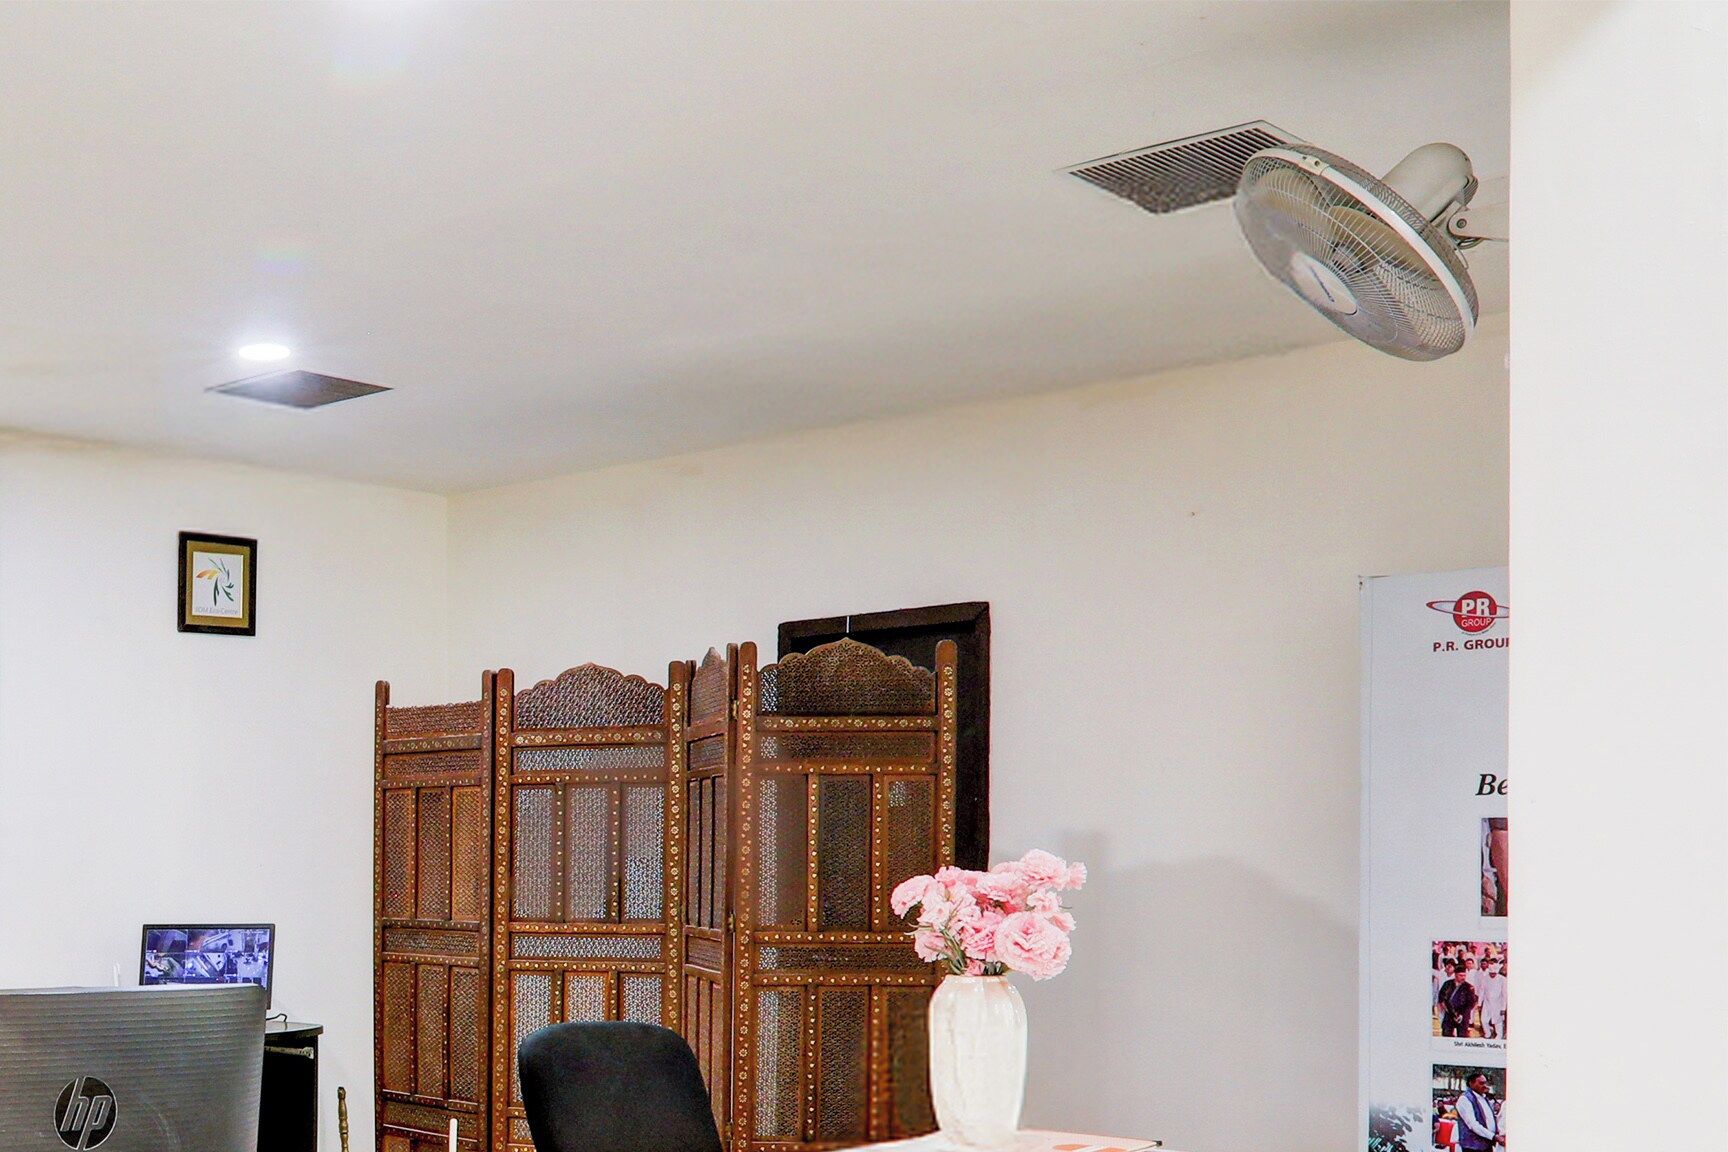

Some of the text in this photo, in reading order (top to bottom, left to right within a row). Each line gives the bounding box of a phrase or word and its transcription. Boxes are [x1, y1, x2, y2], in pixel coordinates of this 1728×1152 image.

[1461, 598, 1491, 617] PR
[1461, 617, 1492, 628] GROUP
[1433, 641, 1459, 652] P.R.
[58, 1077, 114, 1150] hp
